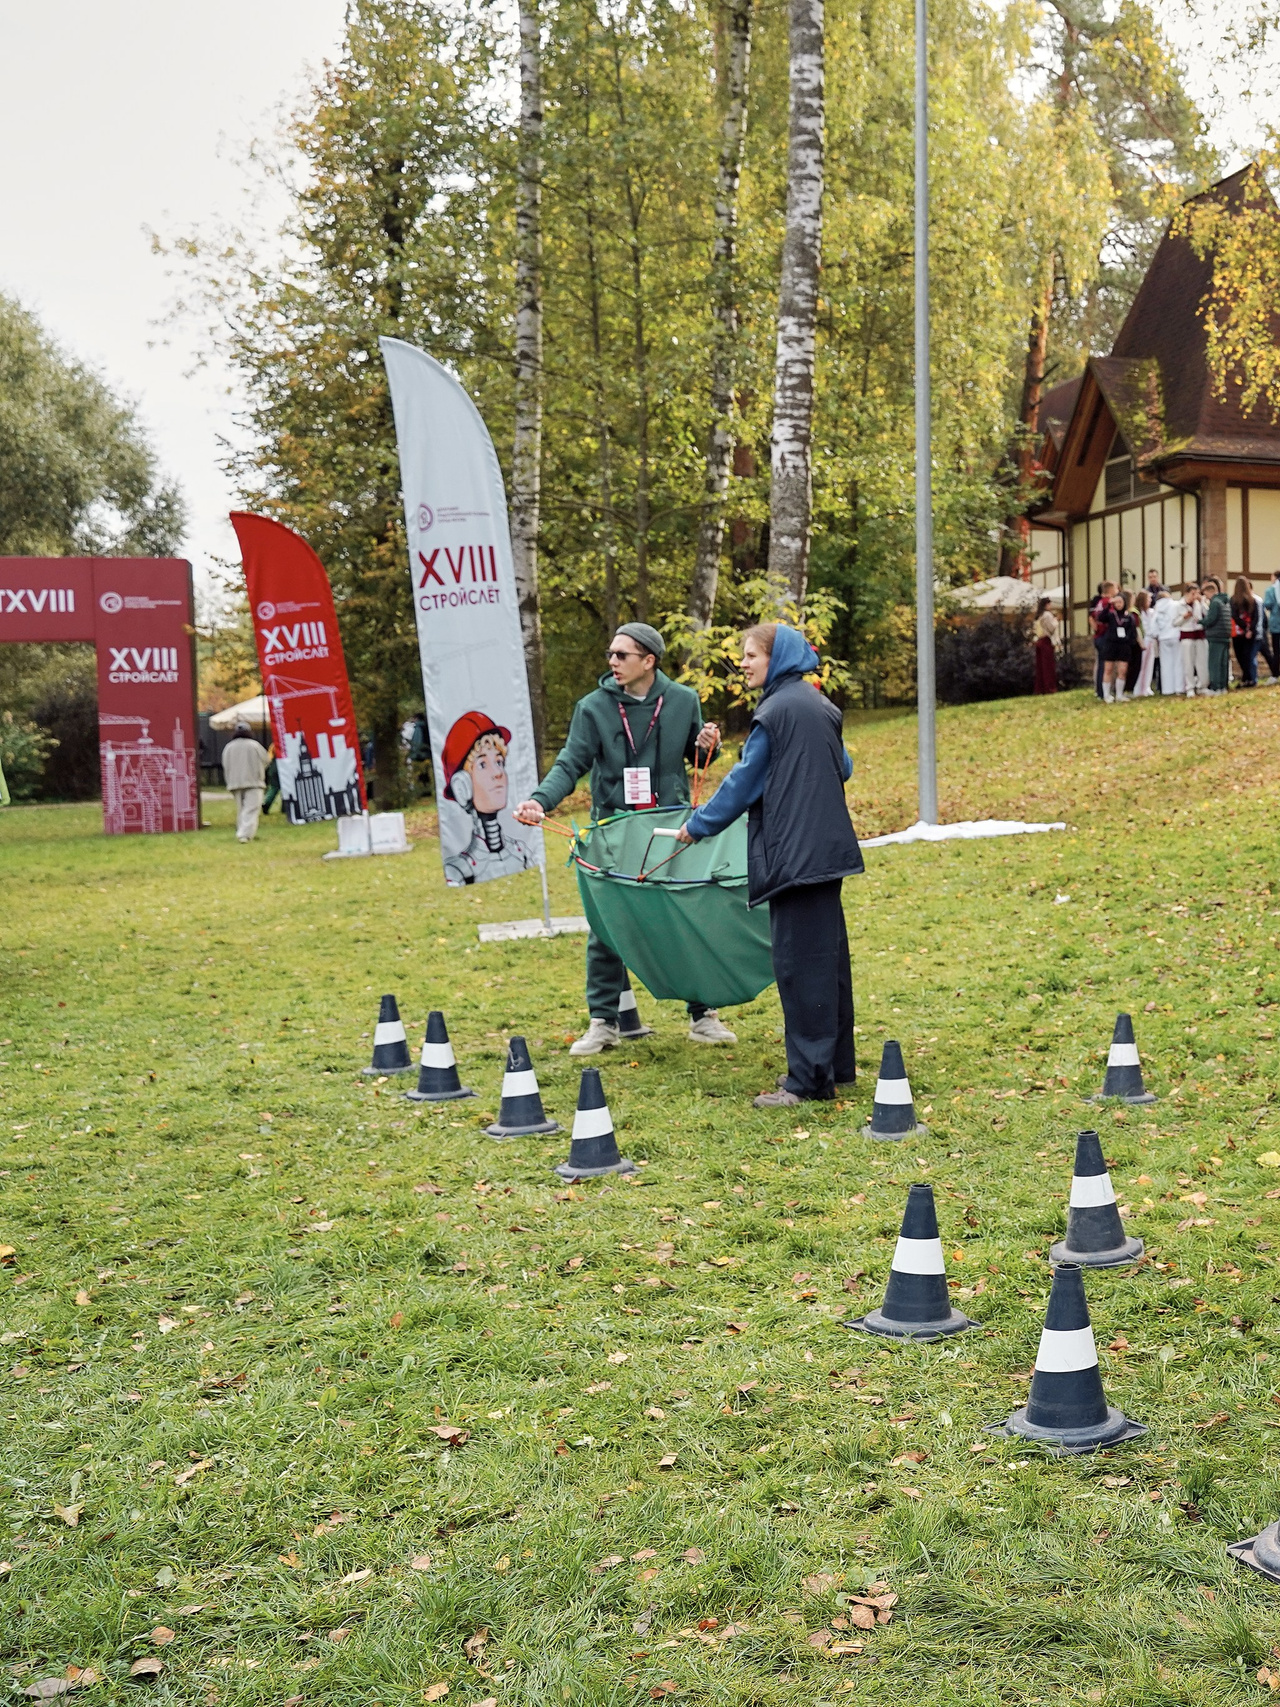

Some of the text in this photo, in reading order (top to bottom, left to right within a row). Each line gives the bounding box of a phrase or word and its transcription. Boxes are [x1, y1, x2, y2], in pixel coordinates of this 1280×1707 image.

[419, 545, 497, 589] XVIII
[419, 585, 500, 611] СТРОЙСЛЁТ
[261, 620, 327, 653] XVIII
[109, 647, 178, 671] XVIII
[264, 645, 329, 666] СТРОЙСЛЁТ
[108, 670, 179, 683] СТРОЙСЛЁТ
